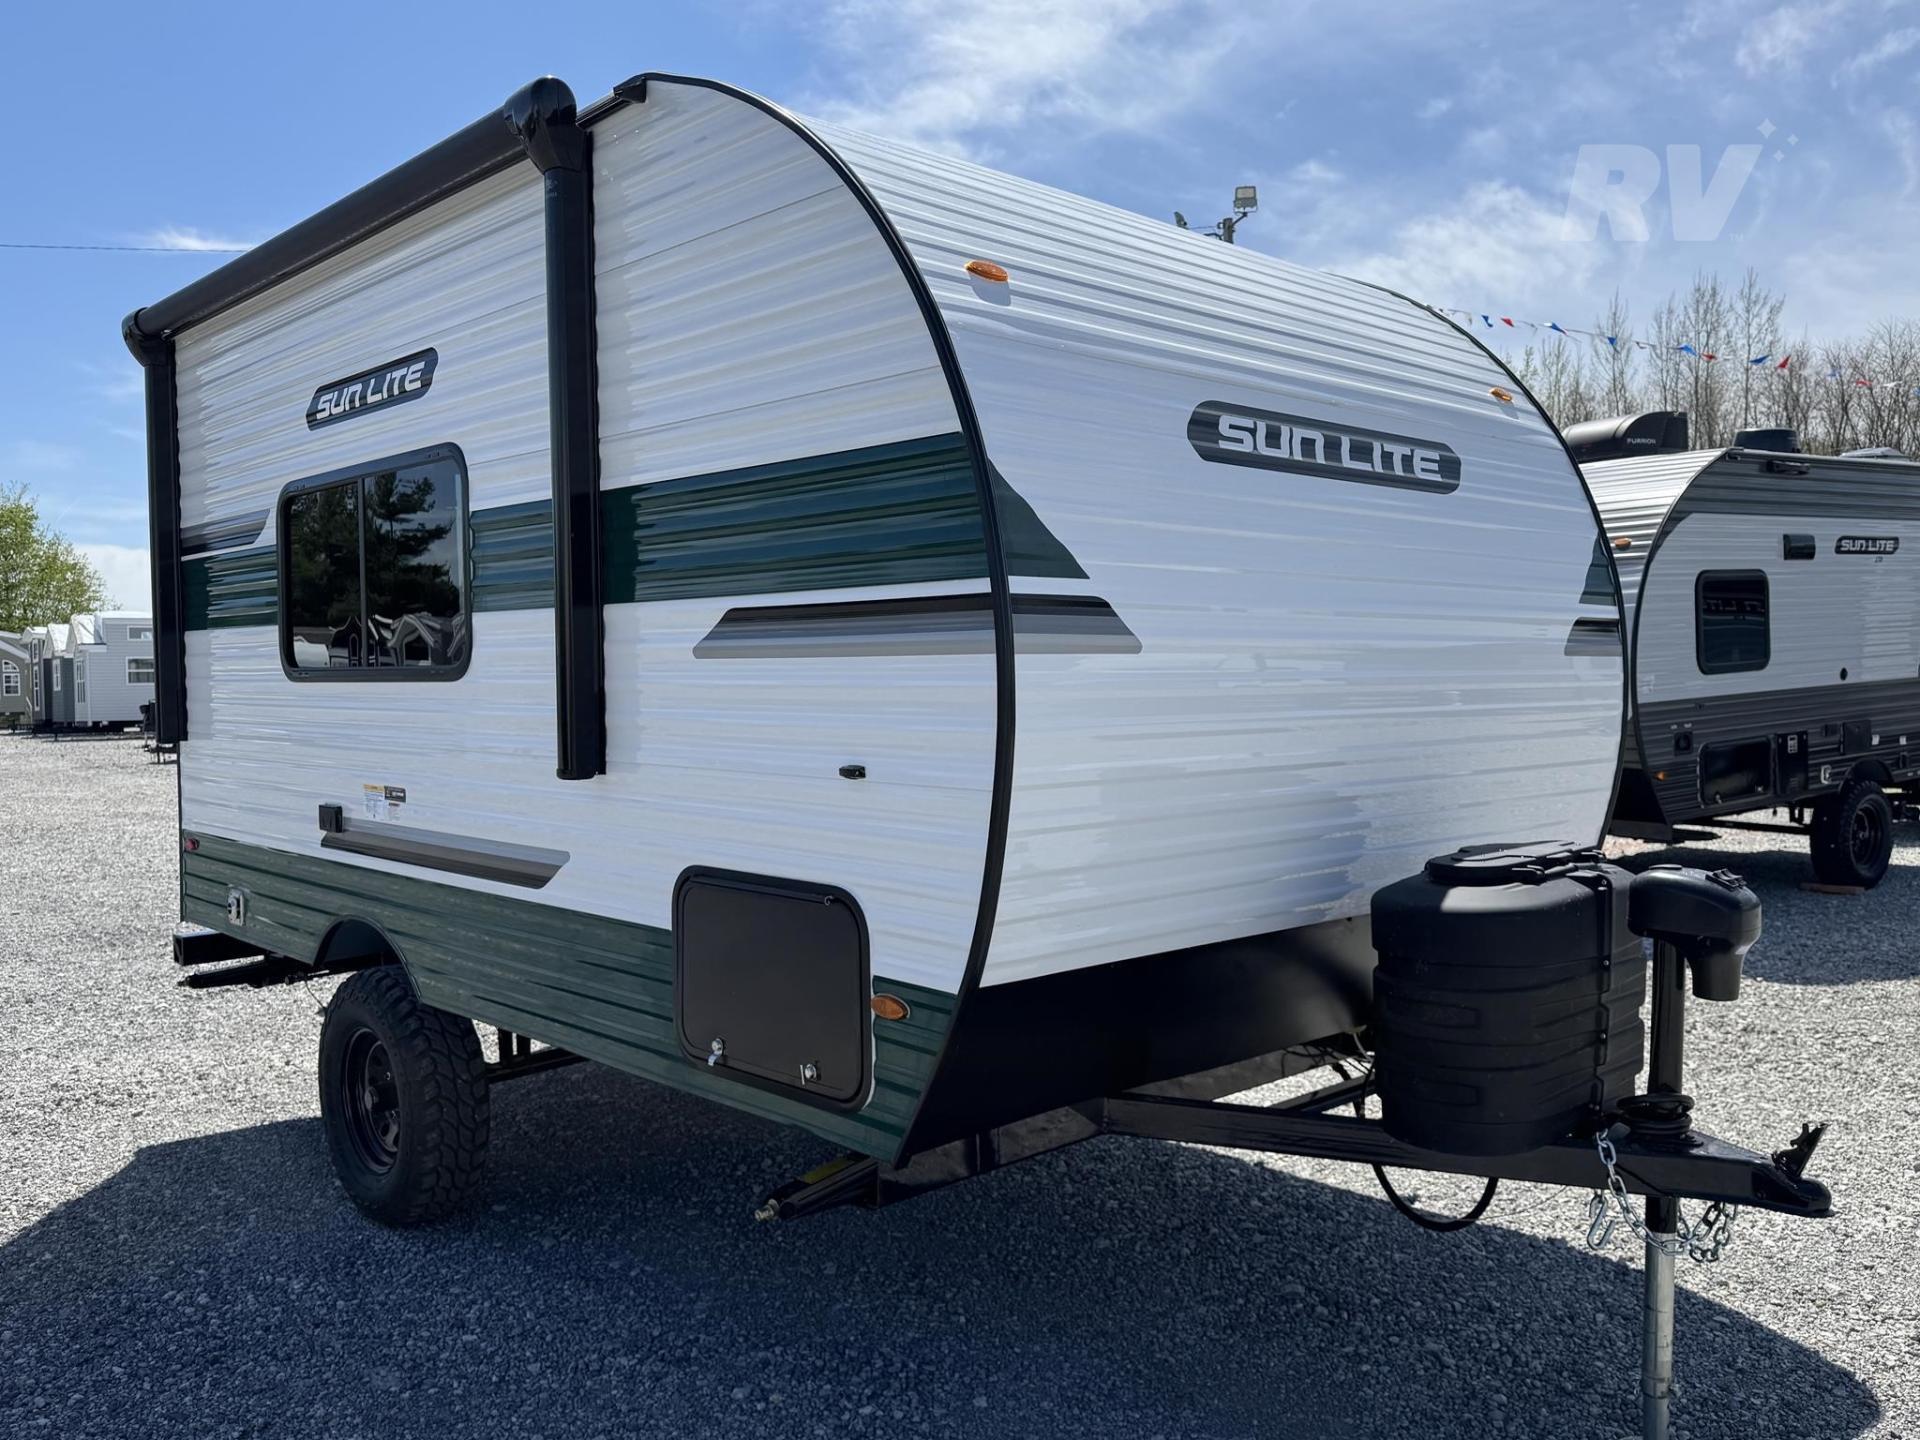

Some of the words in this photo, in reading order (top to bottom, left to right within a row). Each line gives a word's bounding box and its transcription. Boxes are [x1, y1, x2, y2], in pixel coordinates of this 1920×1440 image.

[316, 382, 363, 420] SUN
[366, 361, 426, 404] LITE
[1218, 414, 1326, 465] SUN
[1340, 435, 1443, 482] LITE
[1840, 540, 1865, 551] SUN
[1868, 540, 1895, 551] LITE
